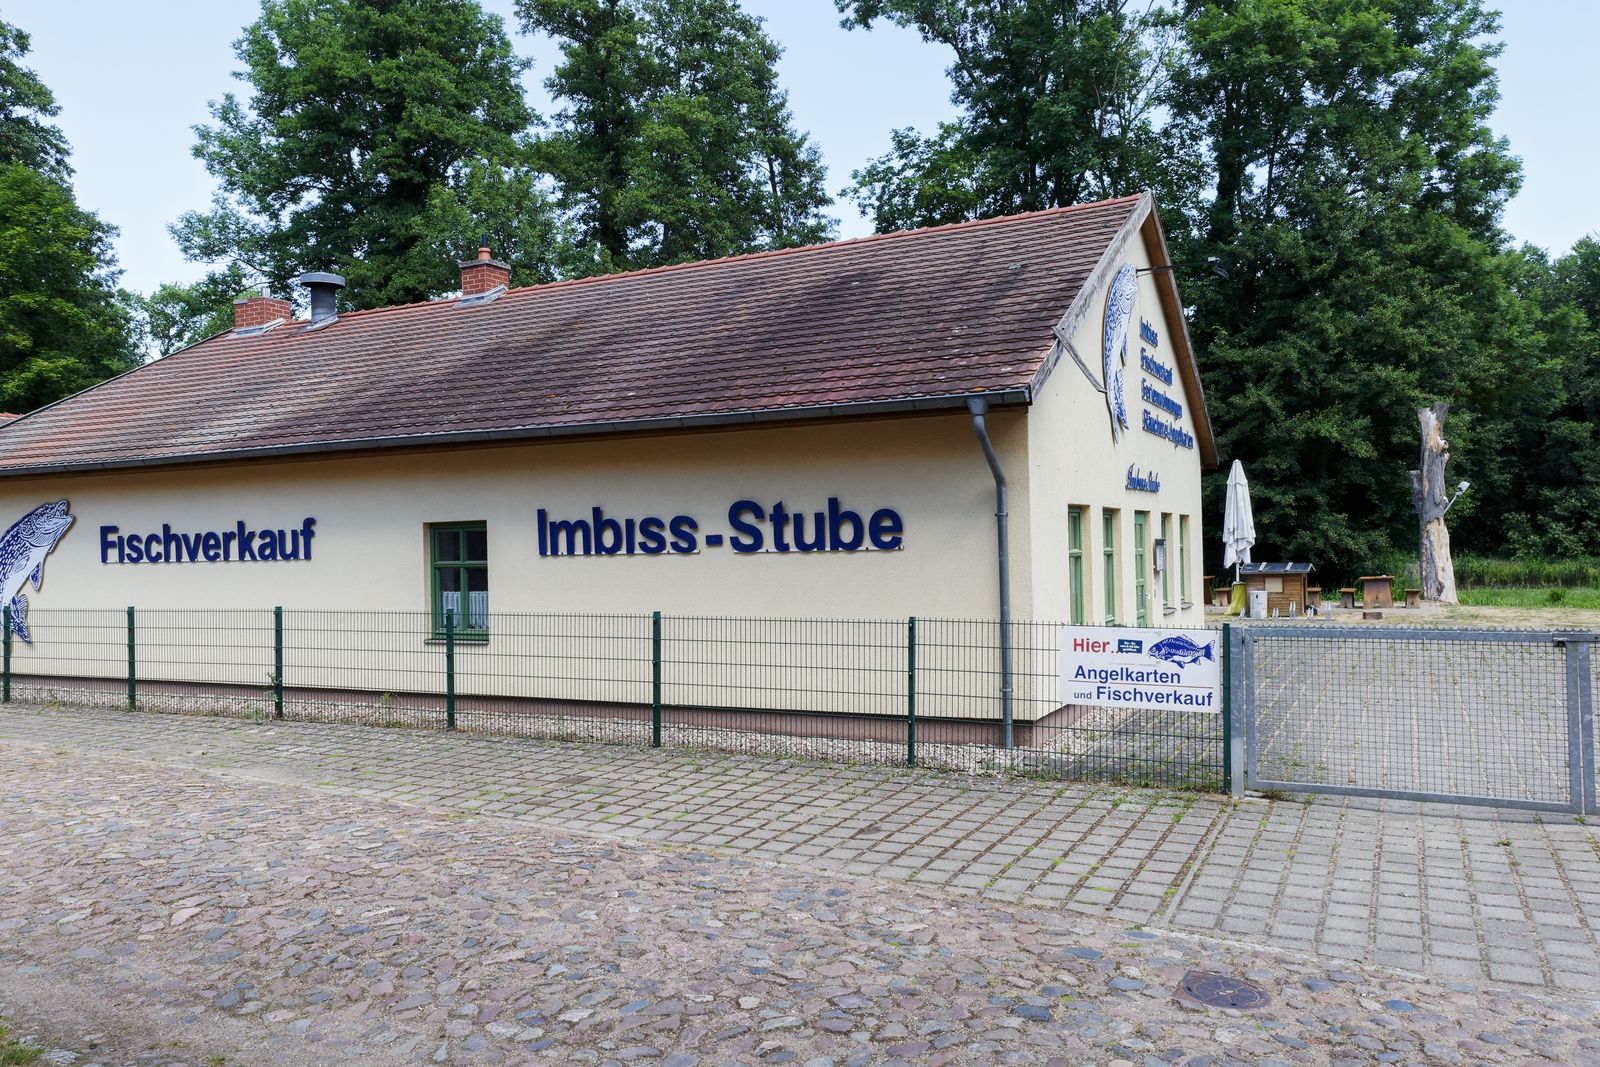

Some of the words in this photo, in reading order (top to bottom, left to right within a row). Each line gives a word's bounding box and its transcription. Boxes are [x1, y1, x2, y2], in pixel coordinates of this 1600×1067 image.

[1139, 316, 1158, 348] Imbiss
[99, 517, 316, 563] Fischverkauf
[1074, 665, 1181, 684] Angelkarten
[1073, 691, 1092, 700] und
[1096, 686, 1214, 707] Fischverkauf
